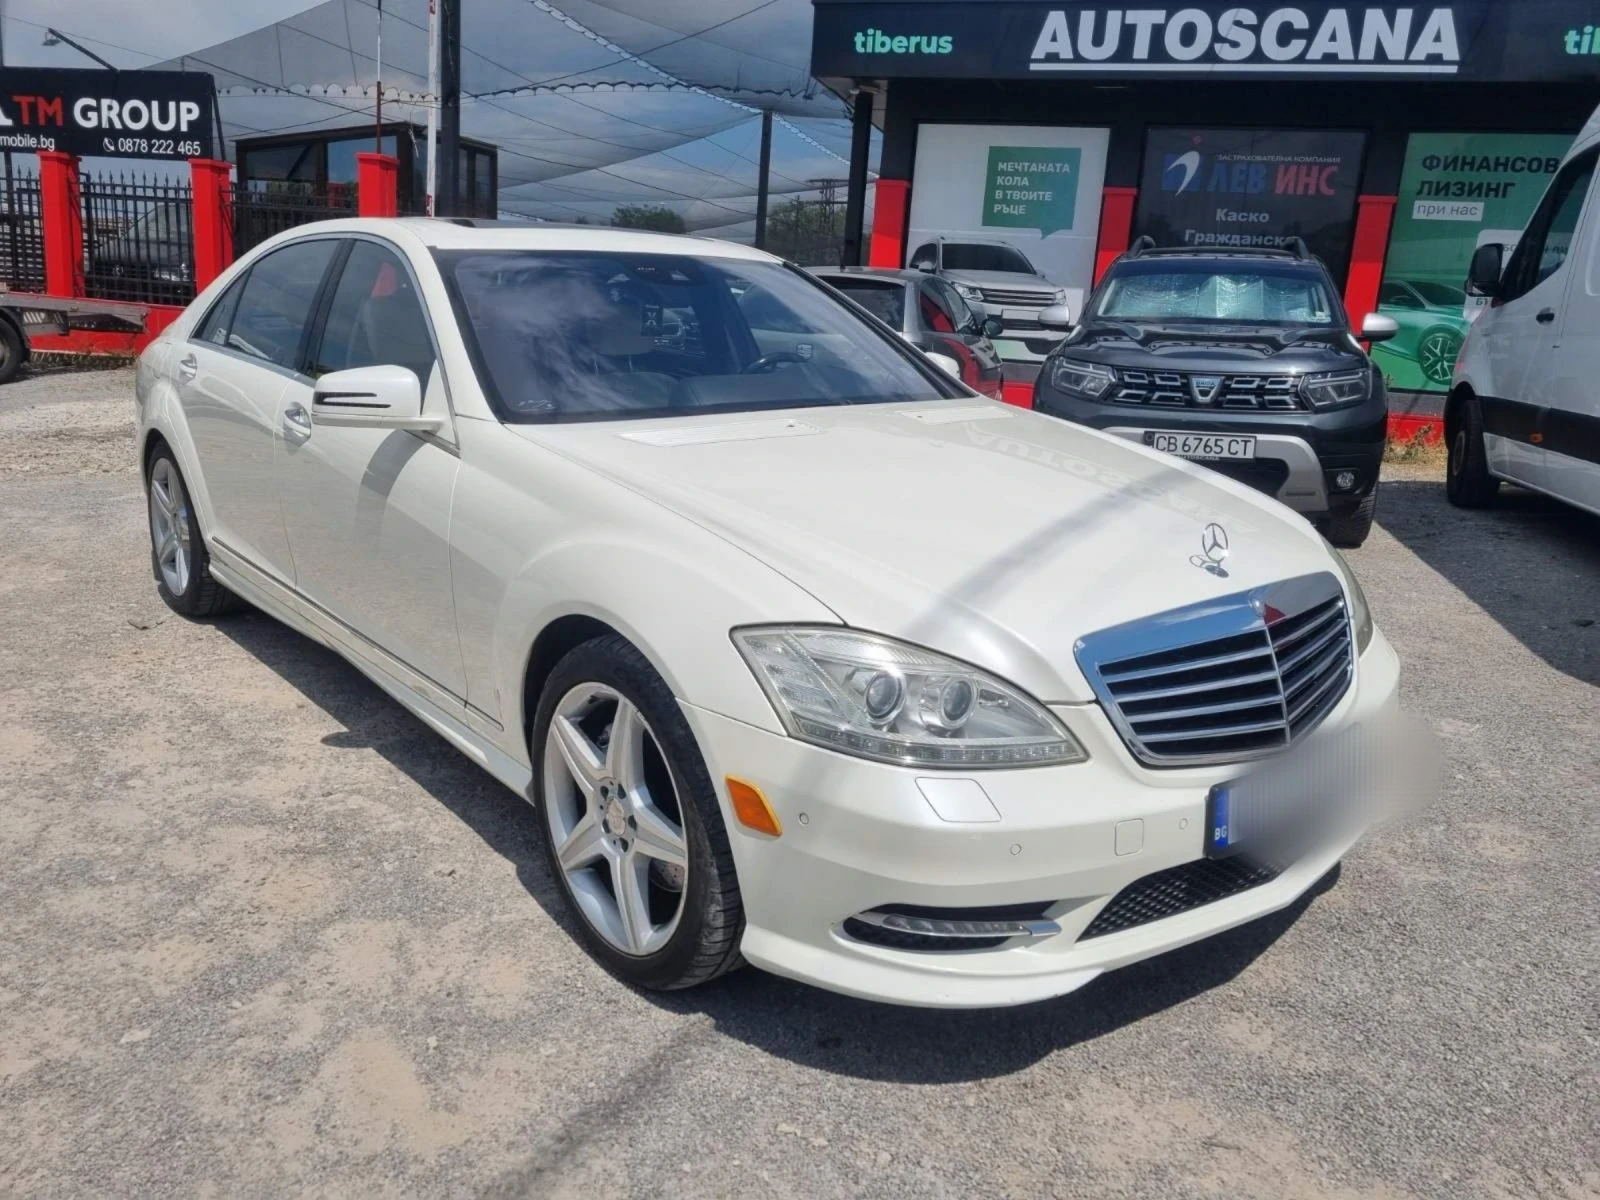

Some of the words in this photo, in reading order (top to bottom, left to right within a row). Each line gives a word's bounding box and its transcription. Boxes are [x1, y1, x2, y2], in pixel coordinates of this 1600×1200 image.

[854, 29, 953, 54] tiberus
[1030, 8, 1460, 61] AUTOSCANA
[0, 95, 63, 127] TM
[73, 97, 200, 132] GROUP
[118, 138, 148, 153] 0878
[151, 139, 174, 155] 222
[177, 141, 201, 156] 465
[998, 161, 1070, 173] МЕЧТАНАТА
[996, 176, 1029, 186] КОЛА
[1207, 163, 1266, 193] ЛЕВ
[1275, 164, 1338, 196] ИНС
[995, 190, 1003, 199] В
[1006, 190, 1052, 201] ТВОИТЕ
[1416, 180, 1515, 198] ЛИЗИНГ
[993, 204, 1027, 215] РЪЦЕ
[1216, 208, 1270, 222] Каско
[1417, 205, 1445, 217] при
[1450, 205, 1478, 216] нас
[1184, 230, 1290, 246] Гражданск
[1155, 436, 1178, 452] CB
[1182, 437, 1224, 454] 6765
[1228, 439, 1252, 456] CT
[1215, 826, 1227, 840] BG
